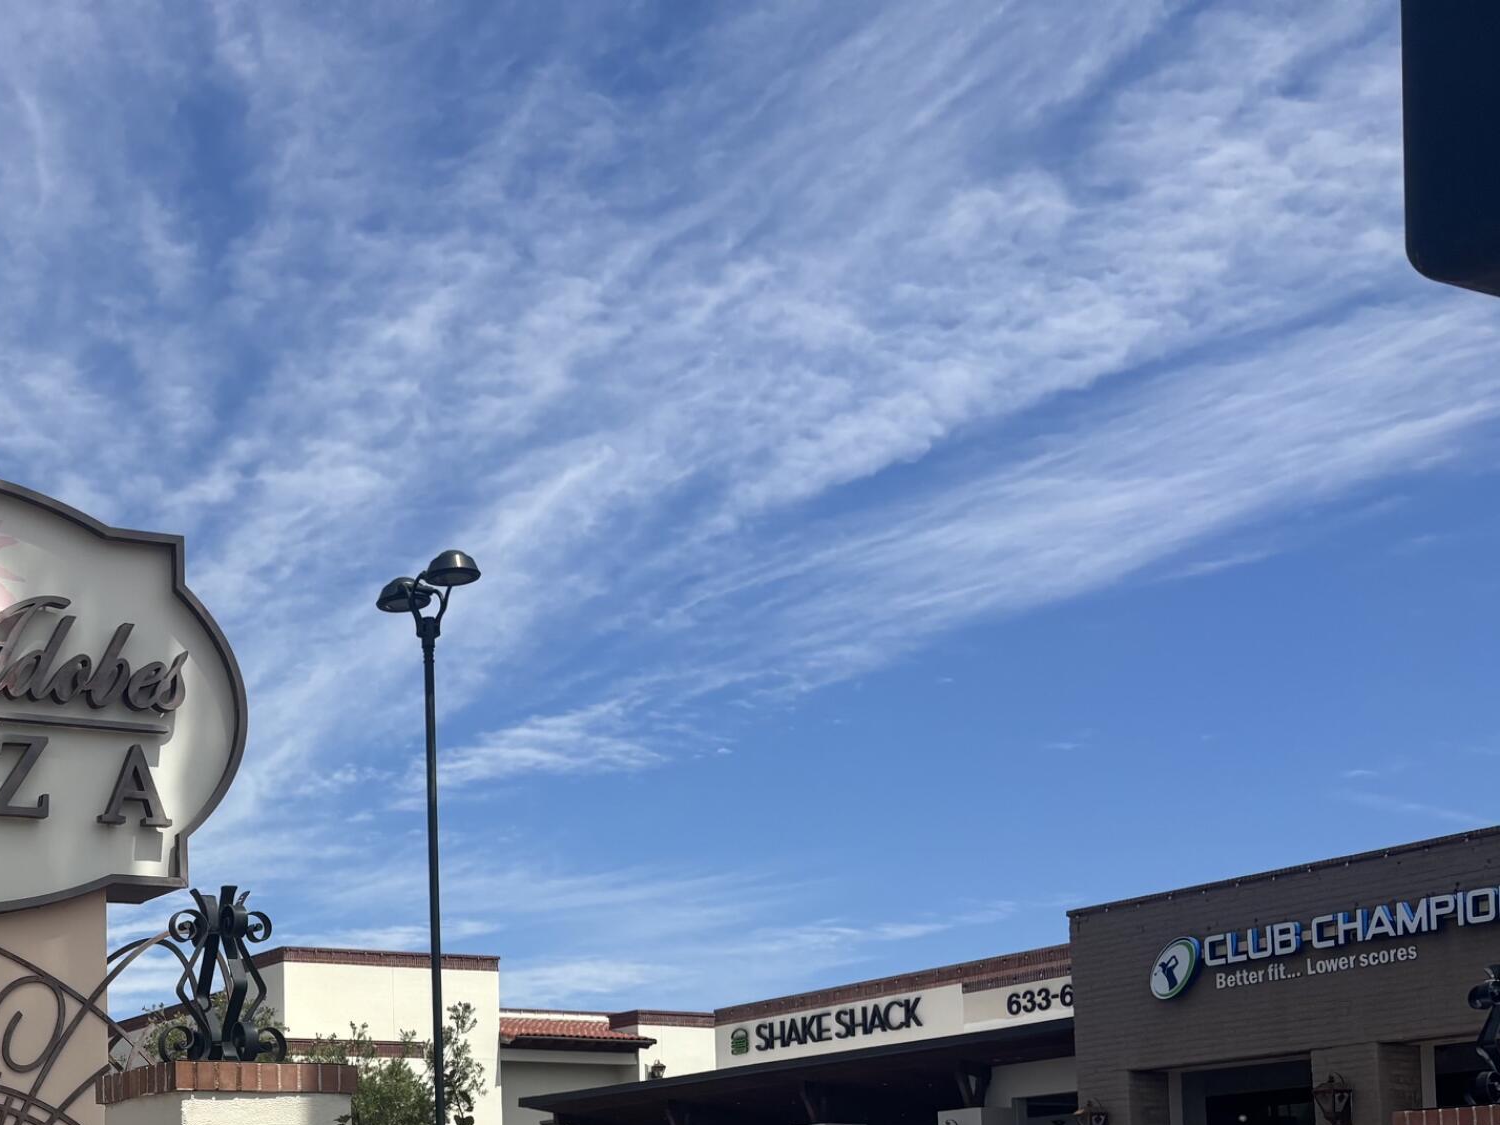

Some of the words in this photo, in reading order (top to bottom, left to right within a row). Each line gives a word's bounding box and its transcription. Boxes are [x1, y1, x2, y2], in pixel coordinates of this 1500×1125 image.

[1203, 921, 1301, 967] CLUB
[1311, 886, 1500, 949] CHAMPIO
[1216, 969, 1265, 989] Better
[1268, 963, 1301, 981] fit...
[1307, 956, 1357, 976] Lower
[1359, 945, 1418, 966] scores
[755, 1012, 833, 1051] SHAKE
[835, 997, 923, 1039] SHACK
[1007, 984, 1073, 1015] 633-6
